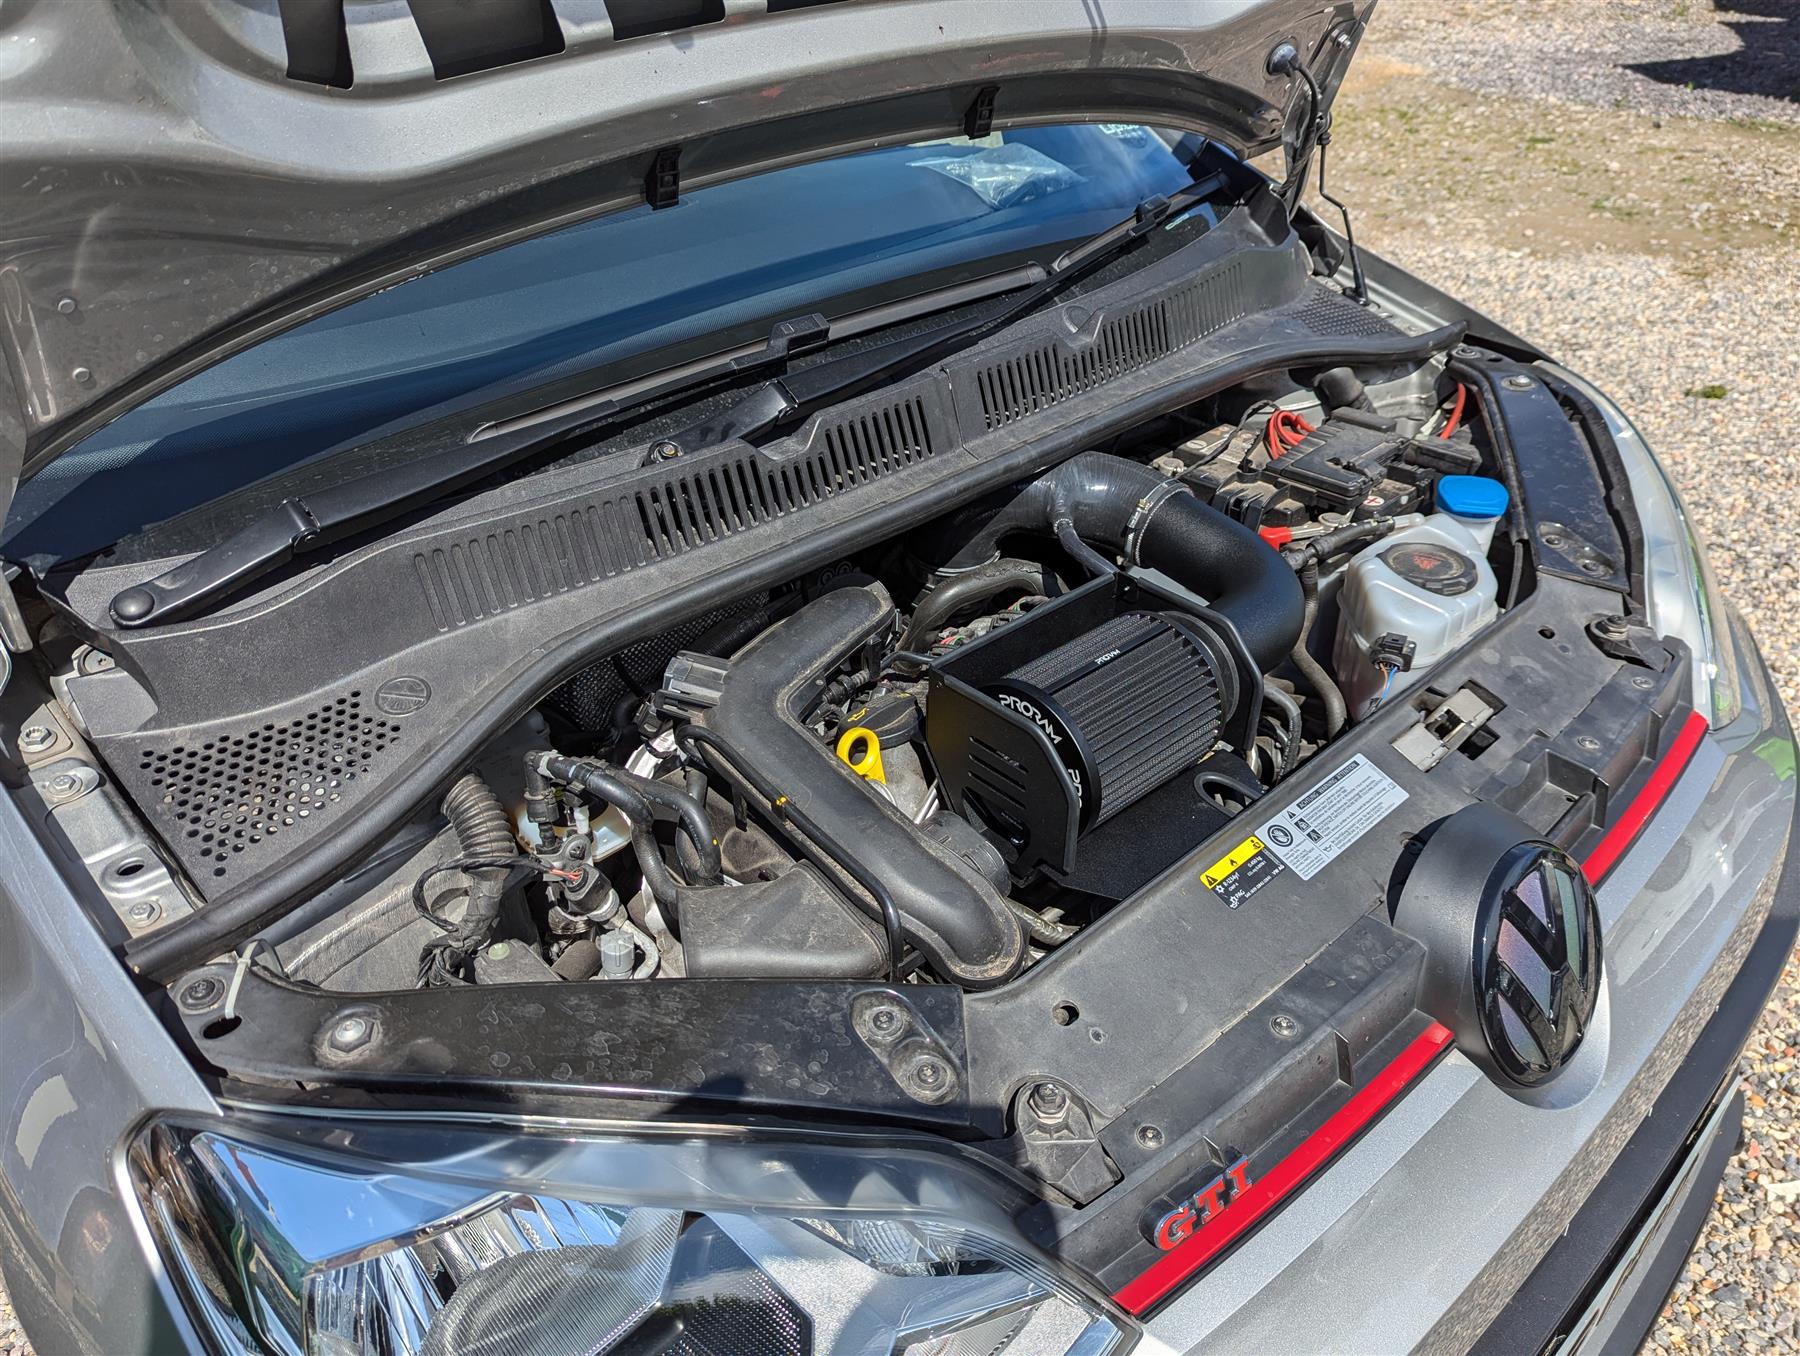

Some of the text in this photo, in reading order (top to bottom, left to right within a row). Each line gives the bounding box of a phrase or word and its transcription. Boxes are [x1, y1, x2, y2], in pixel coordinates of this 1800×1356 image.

[998, 694, 1063, 744] PRORAM
[1317, 777, 1338, 793] WARNING
[1336, 762, 1358, 780] ATTENTION
[1234, 889, 1245, 898] PAG
[1154, 1154, 1252, 1251] GTI
